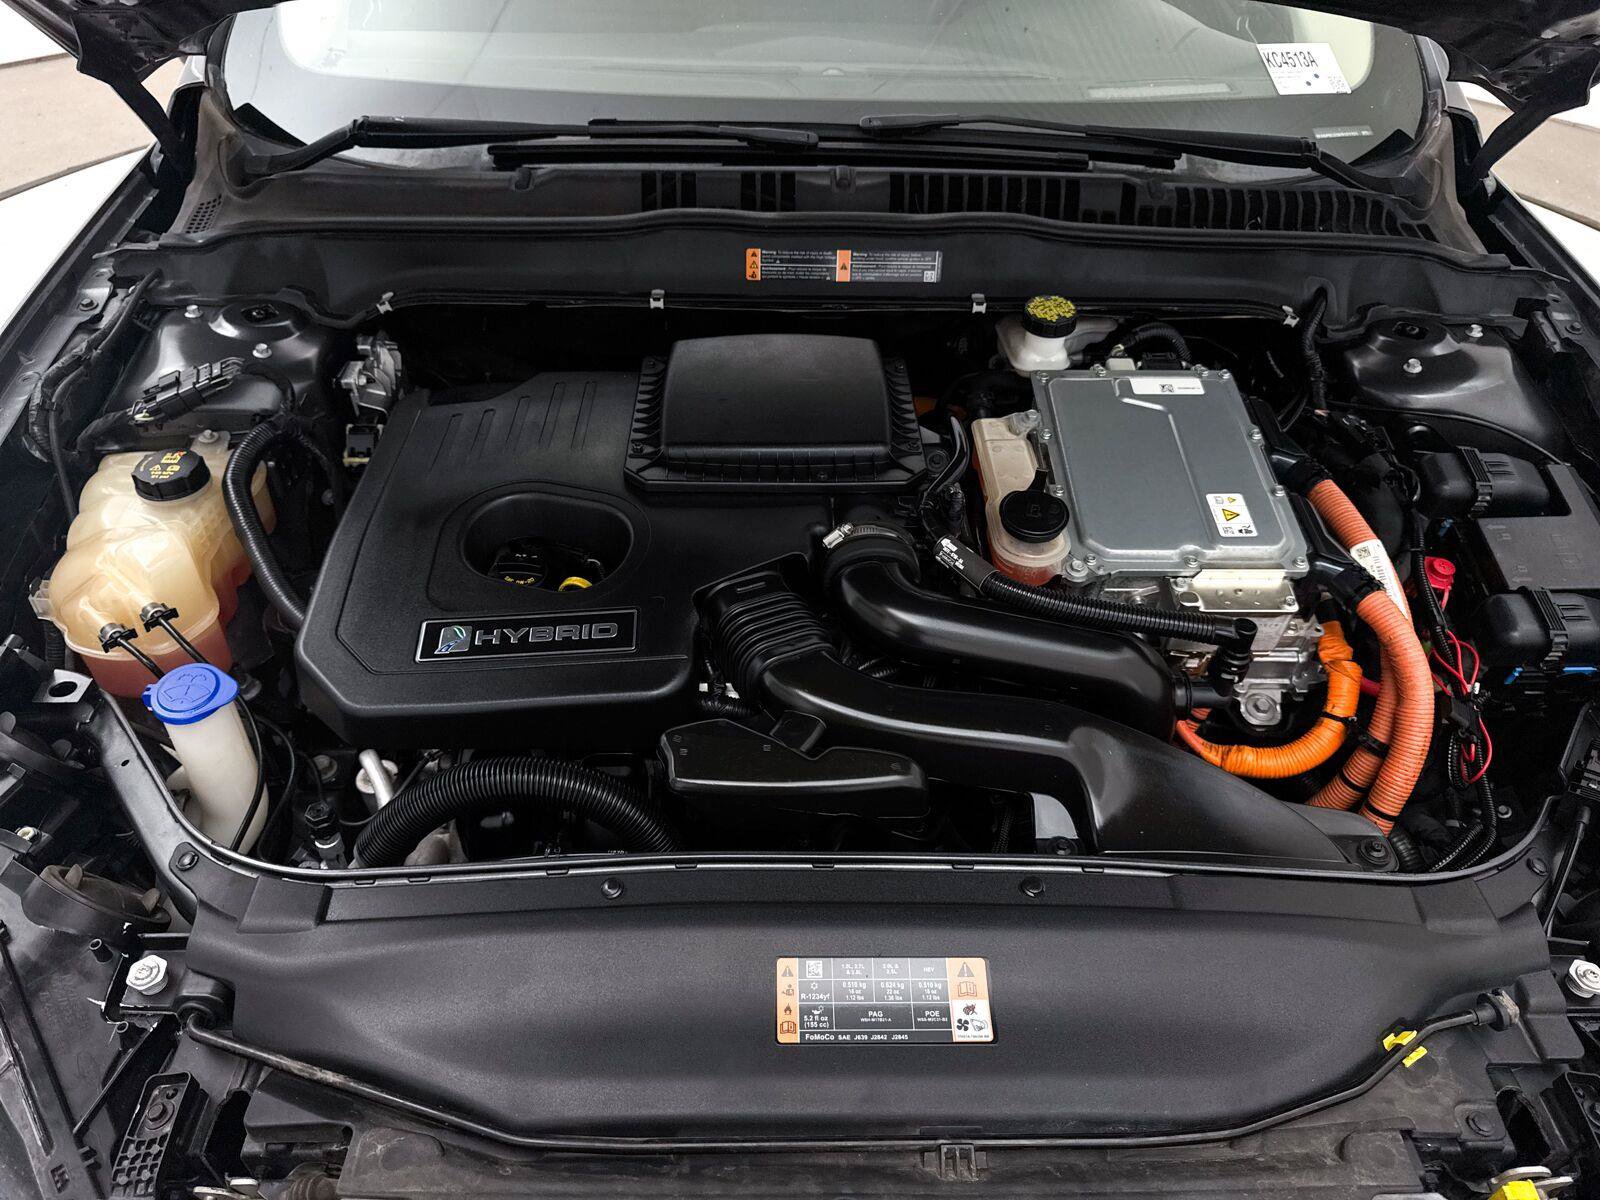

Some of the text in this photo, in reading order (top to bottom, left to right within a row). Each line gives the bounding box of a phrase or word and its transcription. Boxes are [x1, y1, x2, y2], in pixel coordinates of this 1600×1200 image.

[1262, 51, 1318, 68] KC4513A
[474, 622, 618, 646] HYBRID
[800, 993, 830, 1001] R-1234yf
[868, 1010, 883, 1018] PAG
[805, 1033, 835, 1041] FoMoCo
